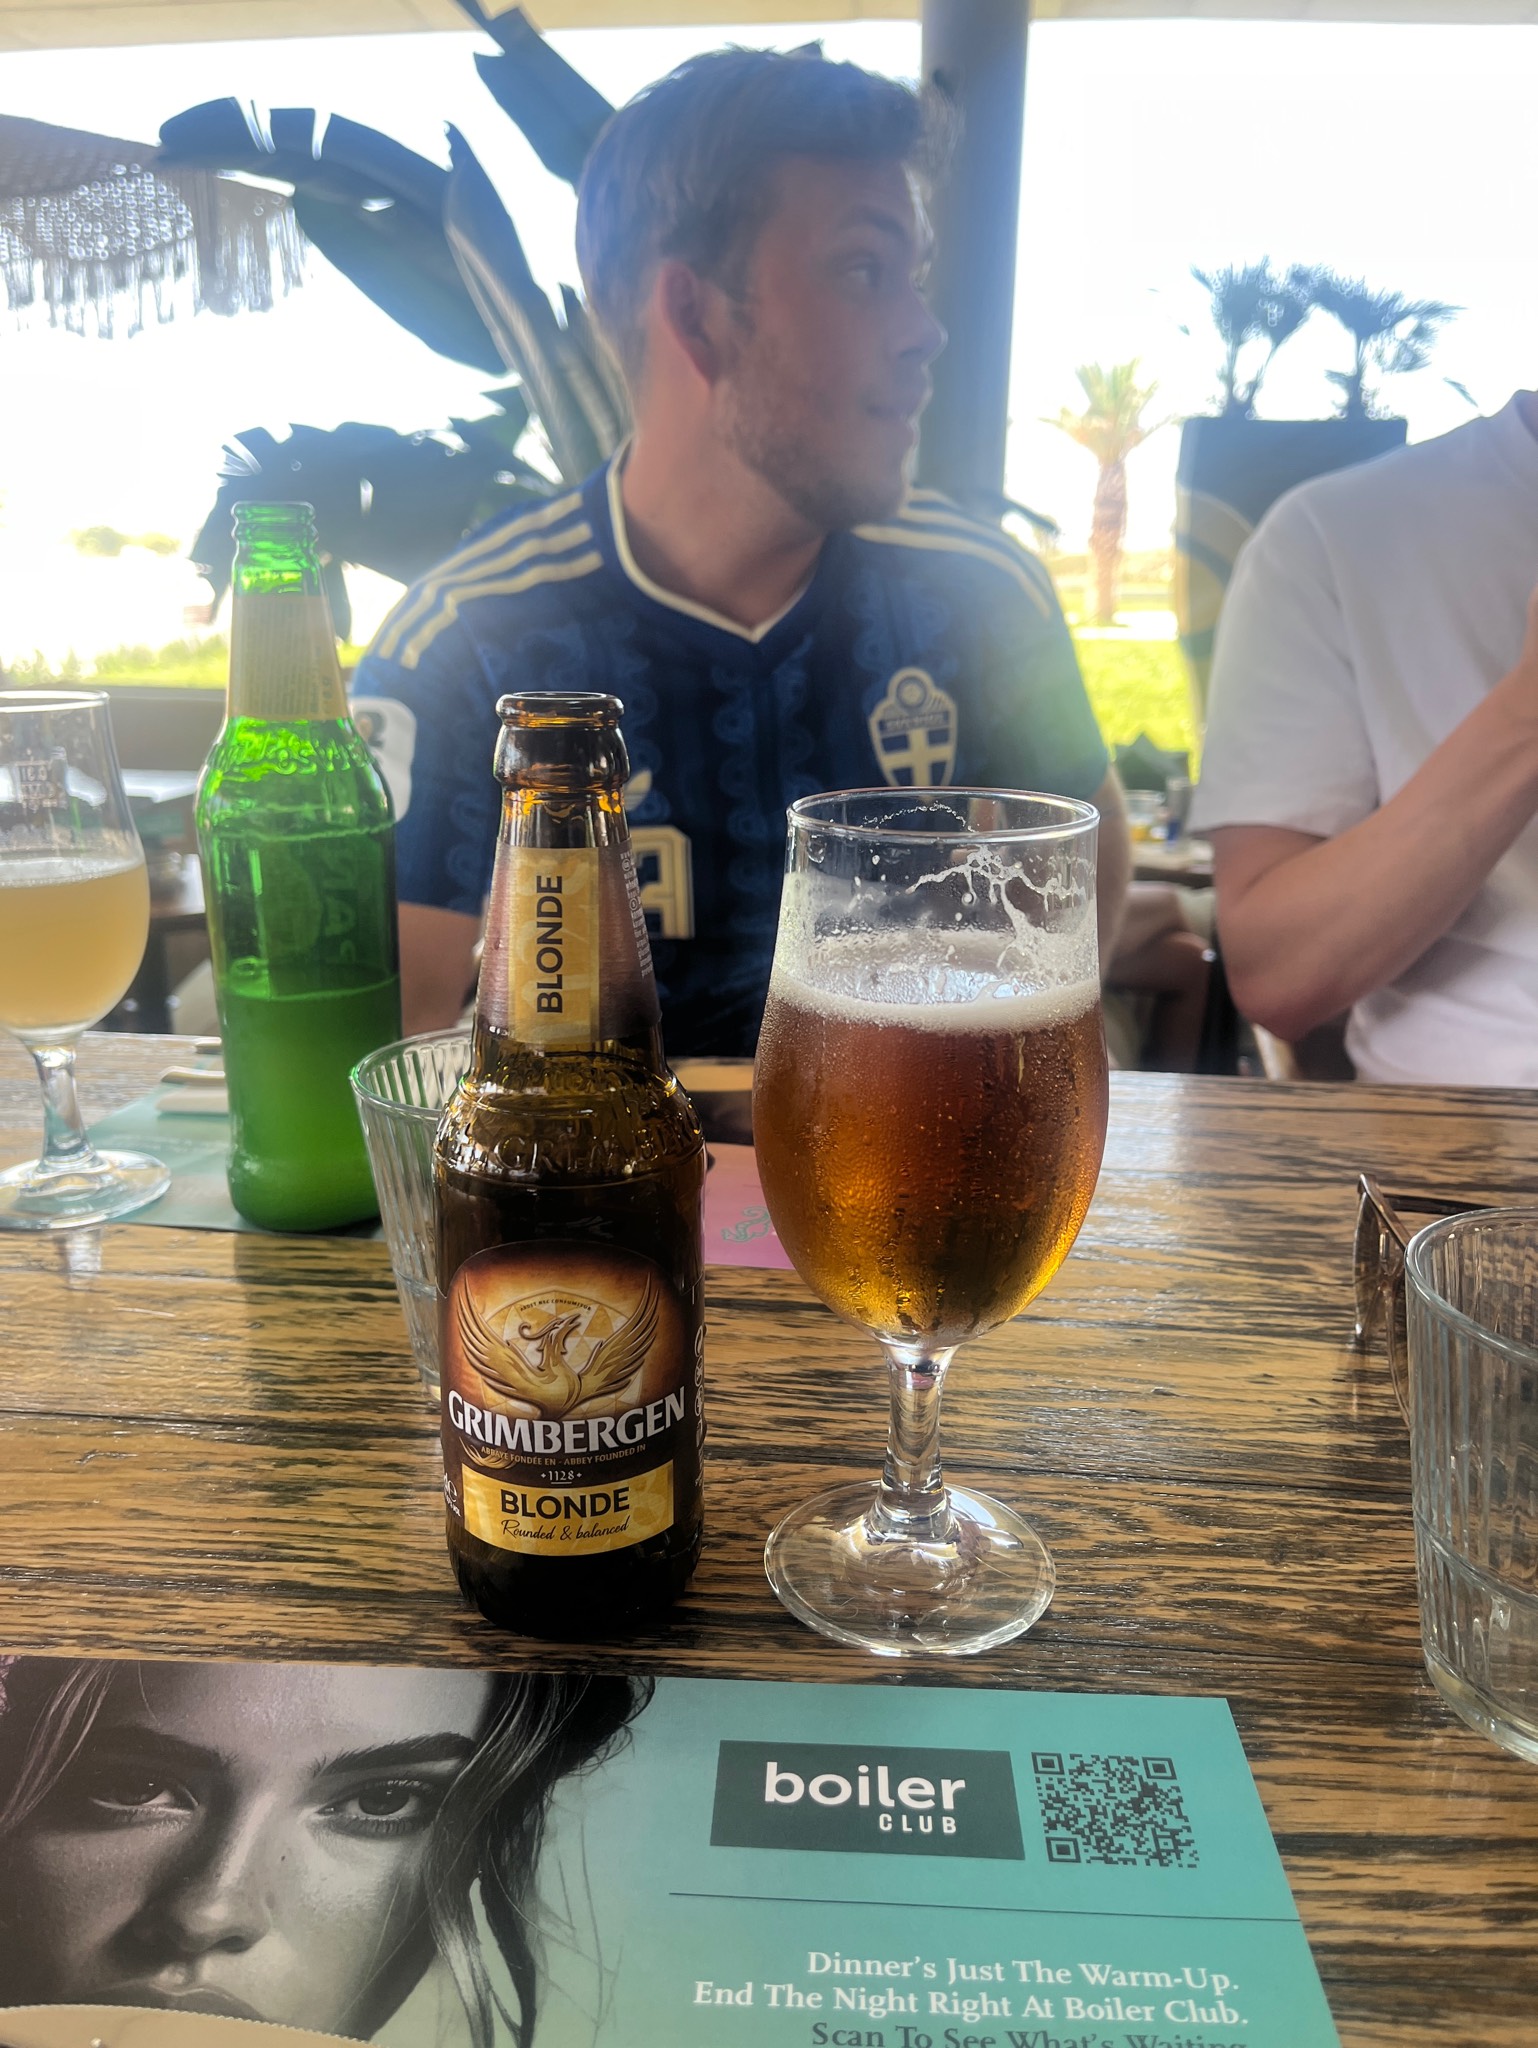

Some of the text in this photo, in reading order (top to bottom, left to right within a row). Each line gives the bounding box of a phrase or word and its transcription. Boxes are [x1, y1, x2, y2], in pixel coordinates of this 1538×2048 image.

[536, 875, 563, 1014] BLONDE
[448, 1386, 686, 1454] GRIMBERGEN
[481, 1446, 509, 1461] ABBAYE
[510, 1454, 542, 1466] FONDÉE
[544, 1458, 556, 1466] EN
[563, 1456, 593, 1466] ABBEY
[594, 1449, 635, 1463] FOUNDED
[636, 1443, 646, 1453] IN
[549, 1470, 575, 1481] 1128
[500, 1486, 630, 1520] BLONDE
[501, 1514, 631, 1541] Rounded & balanced
[764, 1761, 966, 1810] boiler
[878, 1813, 957, 1835] CLUB
[807, 1951, 1240, 1996] Dinner's Just The Warm-Up.
[693, 1981, 1249, 2026] End The Night Right At Boiler Club.
[812, 2022, 884, 2048] Scan
[895, 2024, 933, 2048] To
[943, 2027, 996, 2048] See
[1004, 2030, 1114, 2048] What's
